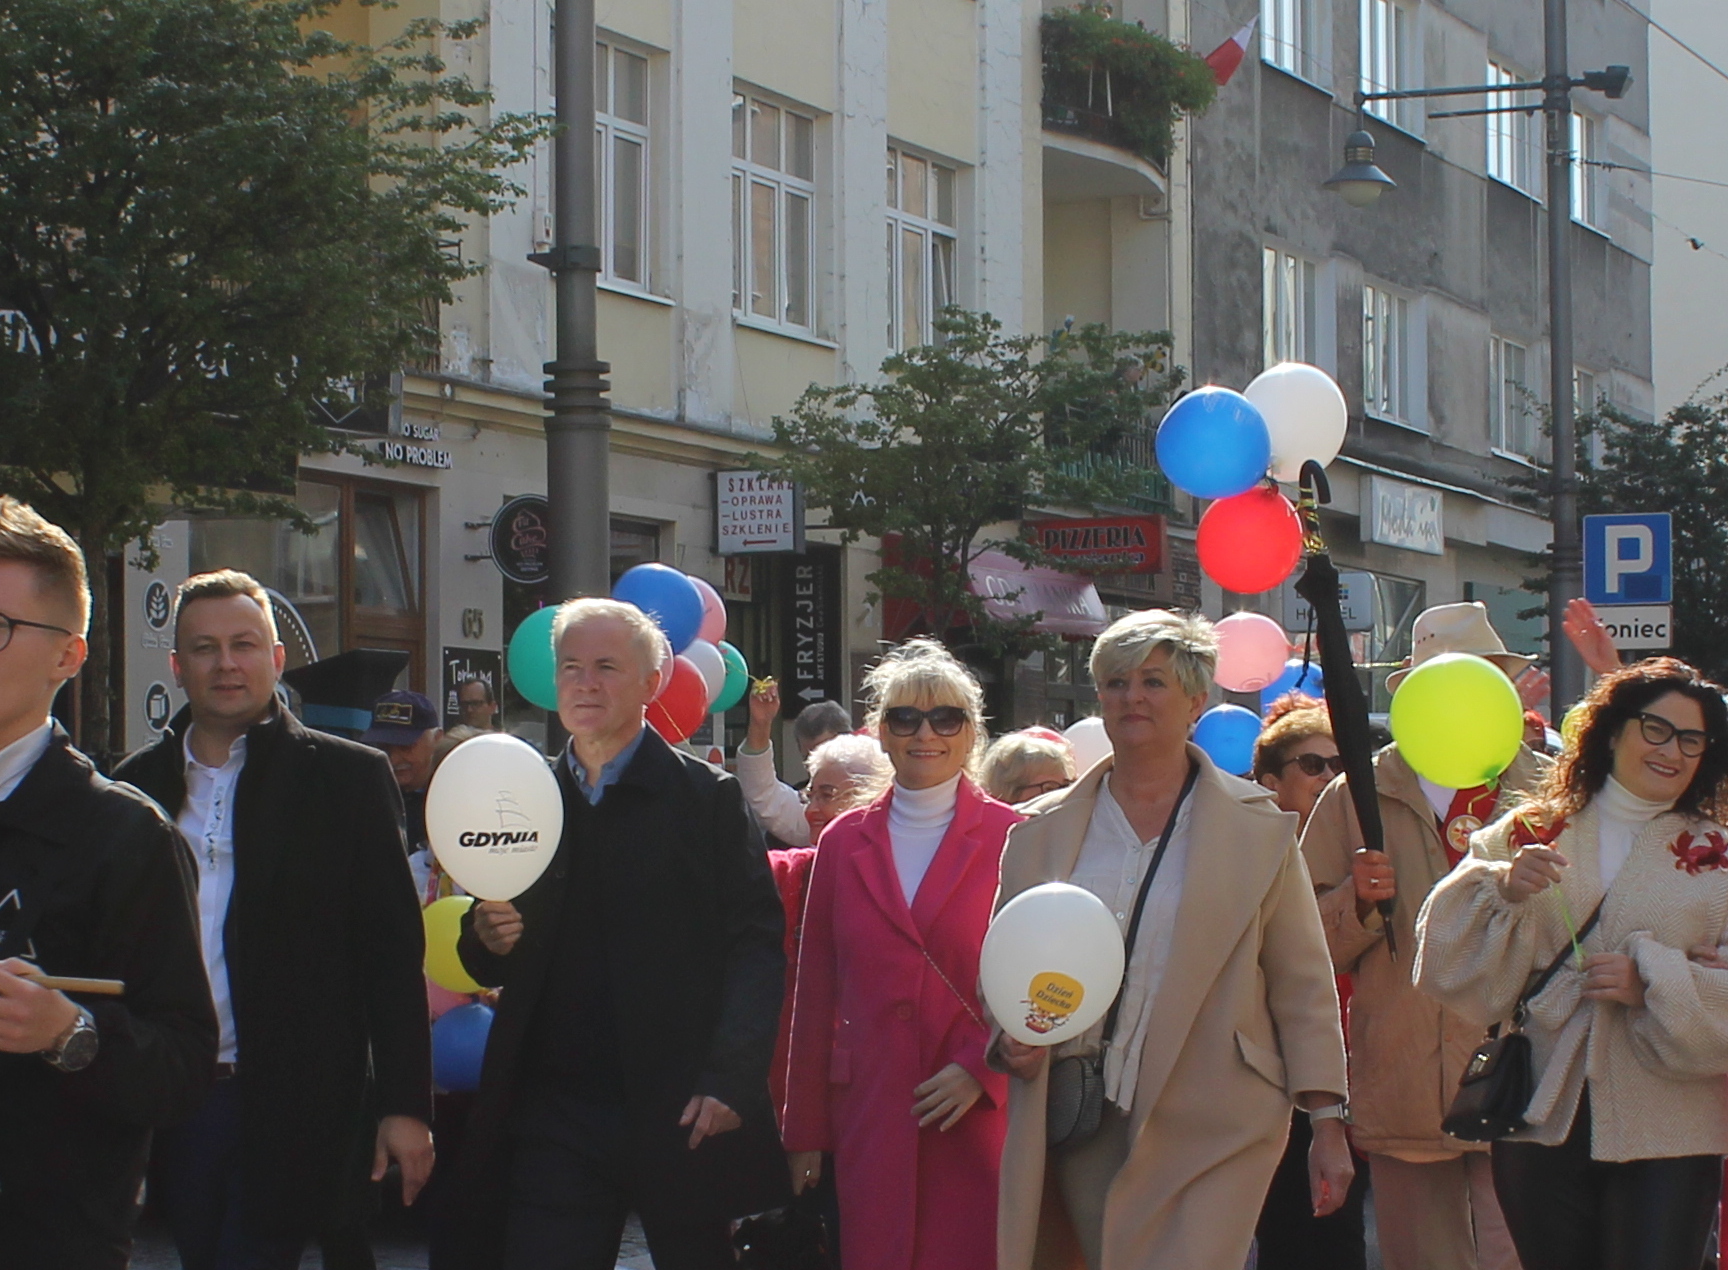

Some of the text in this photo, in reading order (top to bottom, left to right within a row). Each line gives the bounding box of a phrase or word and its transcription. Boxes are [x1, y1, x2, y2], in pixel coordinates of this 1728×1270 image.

[413, 424, 441, 442] SUGAR
[385, 442, 453, 469] NO PROBLEM
[1044, 526, 1146, 551] PIZZERIA
[1605, 524, 1653, 594] P
[462, 607, 485, 639] 65
[796, 565, 814, 680] FRYZJER
[1598, 617, 1666, 639] oniec
[459, 831, 539, 848] GDYNIA
